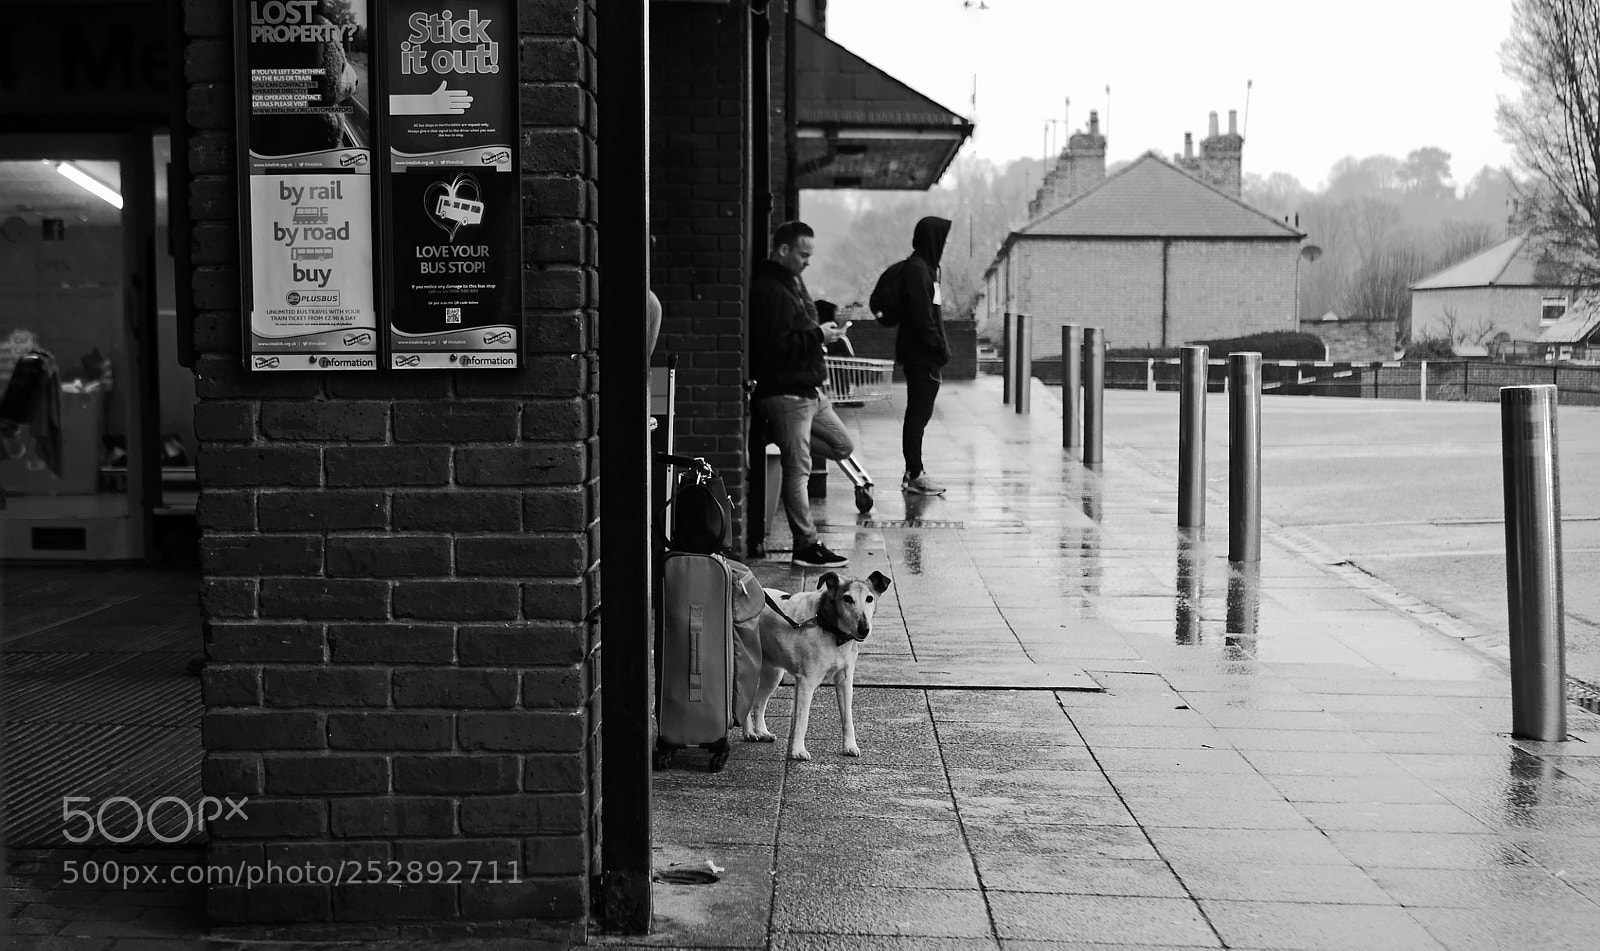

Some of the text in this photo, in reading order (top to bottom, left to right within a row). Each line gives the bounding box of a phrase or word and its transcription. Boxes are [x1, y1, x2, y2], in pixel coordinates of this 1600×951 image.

[250, 1, 318, 24] LOST
[251, 24, 358, 43] PROPERTY?
[408, 9, 492, 44] Stick
[400, 41, 500, 75] it out!
[279, 180, 343, 206] by rail
[273, 221, 350, 247] by road
[416, 245, 490, 258] LOVE YOUR
[292, 263, 332, 288] buy
[420, 261, 486, 274] BUS STOP!
[321, 357, 373, 367] information
[462, 355, 514, 365] information
